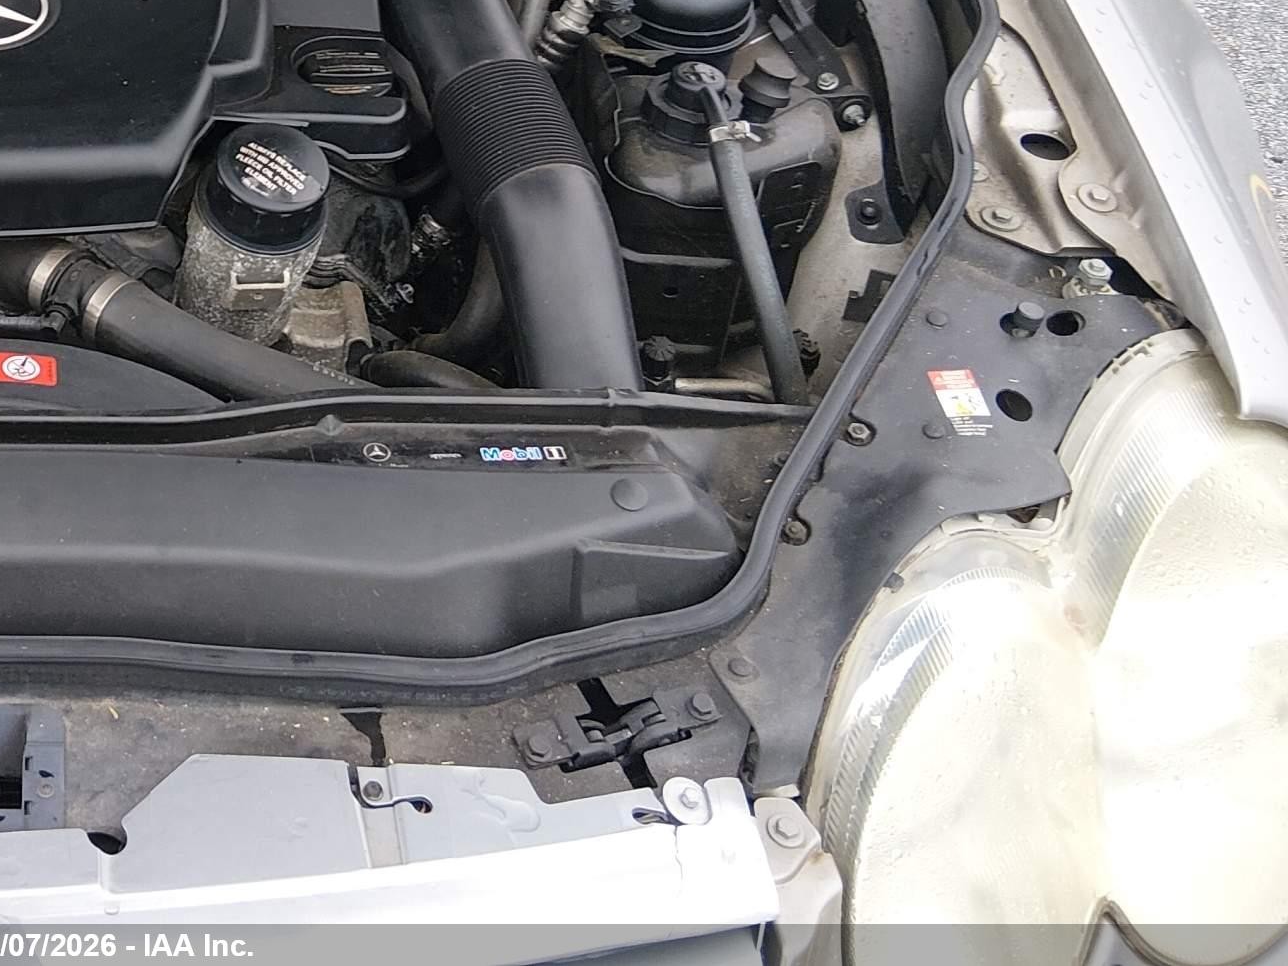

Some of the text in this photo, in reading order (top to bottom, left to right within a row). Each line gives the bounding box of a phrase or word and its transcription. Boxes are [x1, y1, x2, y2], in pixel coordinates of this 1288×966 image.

[235, 153, 263, 171] FLEECE
[261, 167, 274, 178] OIL
[273, 175, 297, 195] FILTER
[239, 146, 258, 159] WITH
[268, 161, 305, 190] APPROVED
[244, 166, 278, 191] ELEMENT
[247, 142, 307, 182] ALWAYS REPLACE
[480, 447, 543, 461] Mobil
